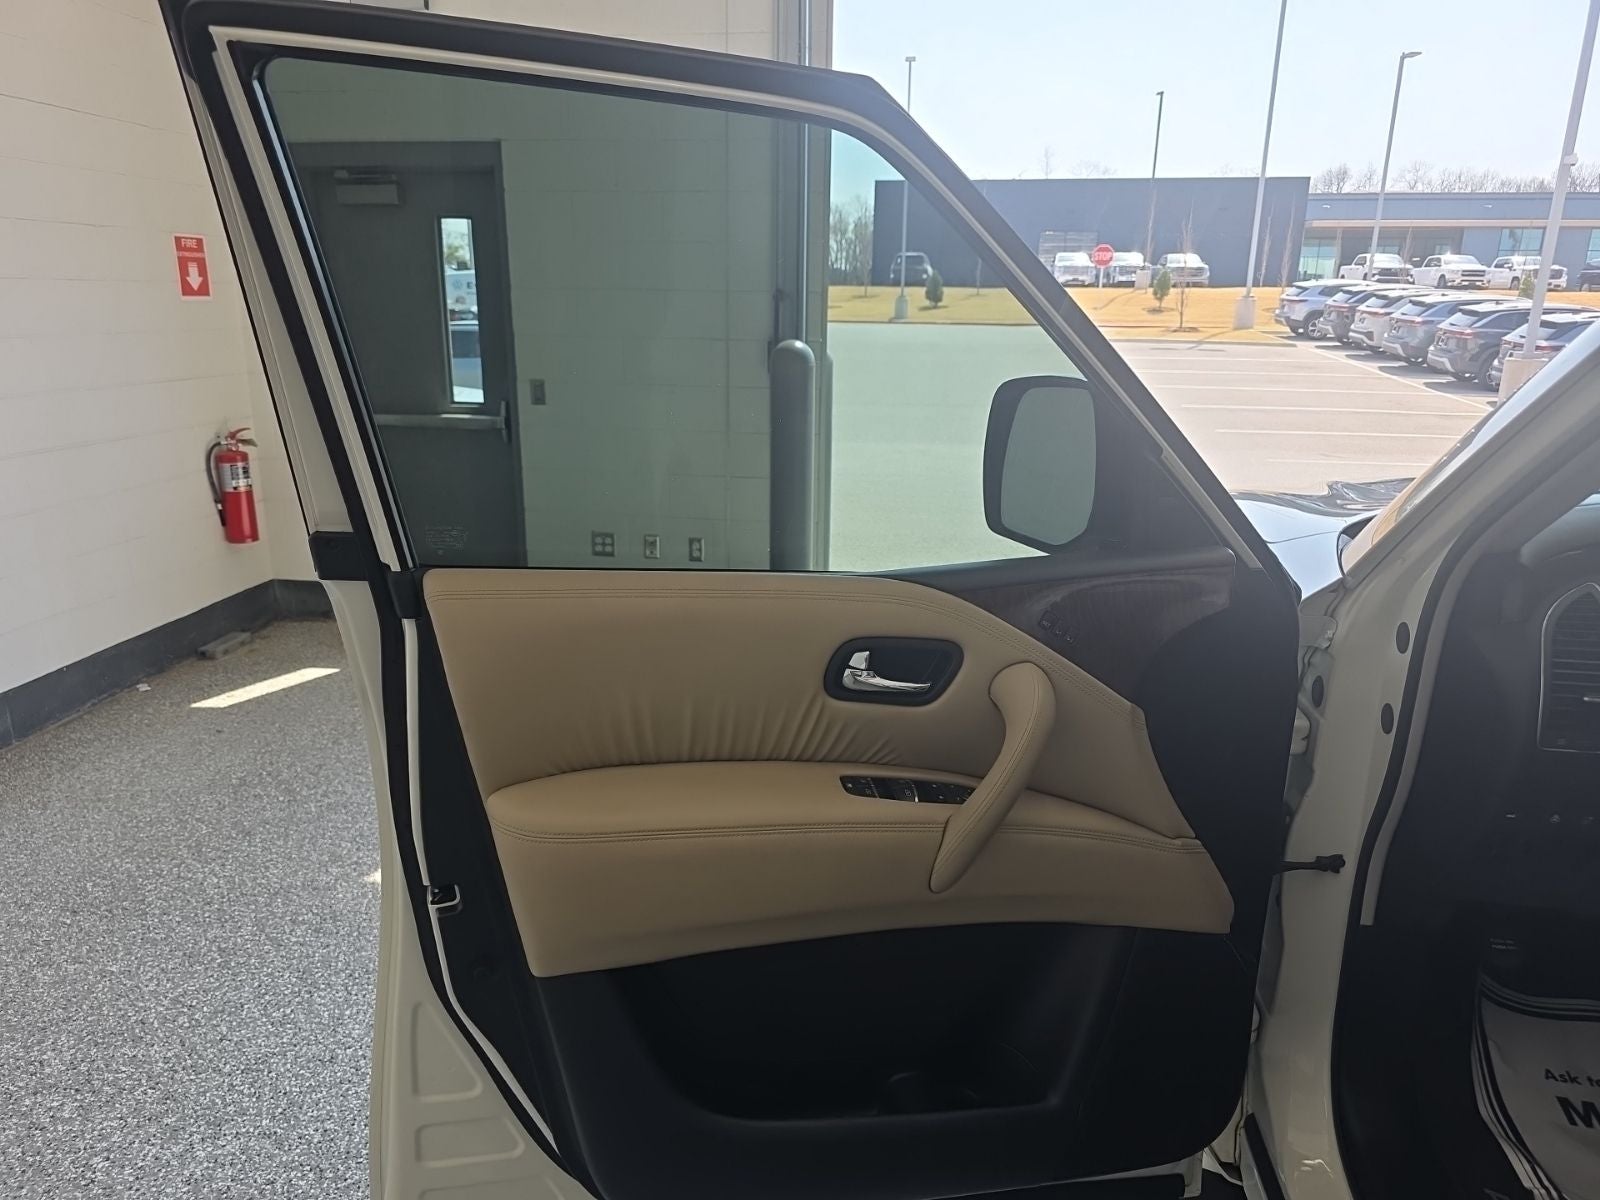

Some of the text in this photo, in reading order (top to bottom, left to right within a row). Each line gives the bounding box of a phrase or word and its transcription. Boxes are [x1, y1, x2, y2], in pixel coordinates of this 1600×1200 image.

[180, 238, 199, 249] FIRE
[1094, 251, 1112, 261] STOP
[1544, 1067, 1582, 1086] Ask
